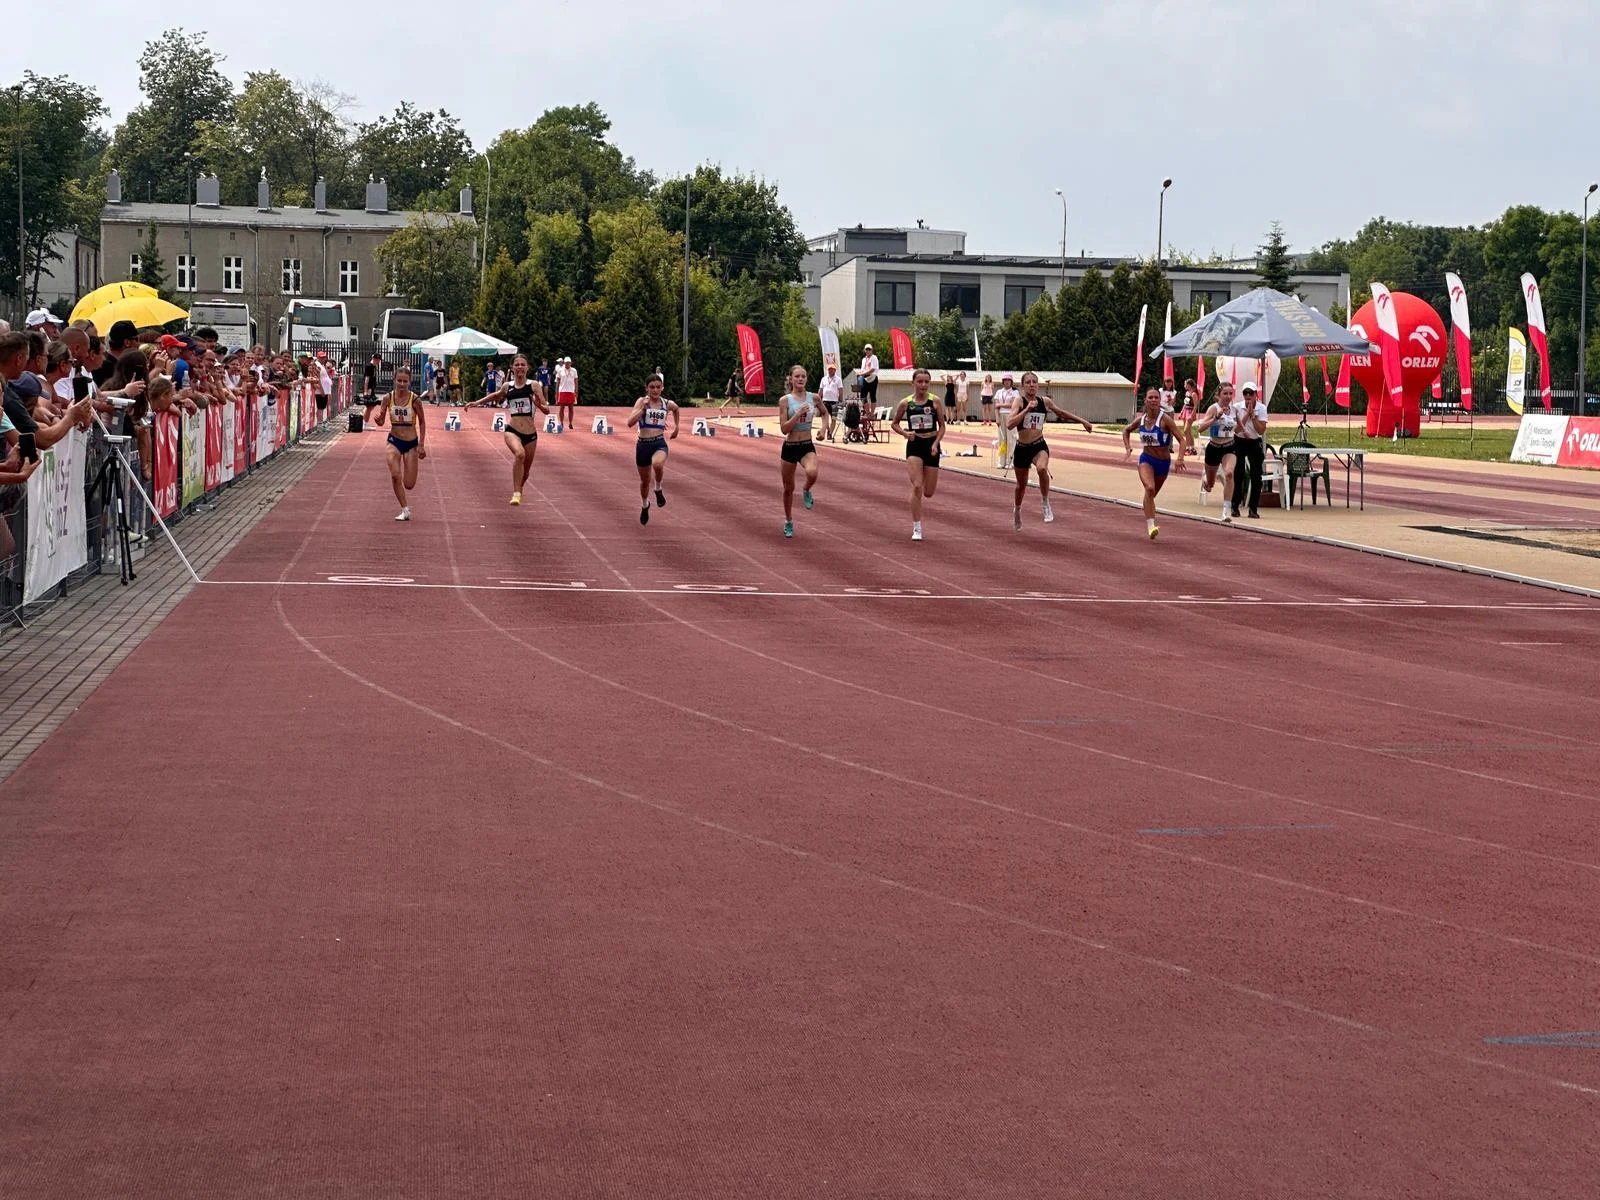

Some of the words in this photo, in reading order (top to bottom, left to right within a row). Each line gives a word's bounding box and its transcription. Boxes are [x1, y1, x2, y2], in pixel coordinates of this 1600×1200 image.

[1350, 355, 1371, 367] LEN
[1401, 356, 1440, 368] ORLEN
[449, 416, 456, 426] 7
[496, 417, 503, 427] 6
[548, 418, 555, 428] 5
[696, 421, 703, 432] 2
[327, 575, 415, 583] 8
